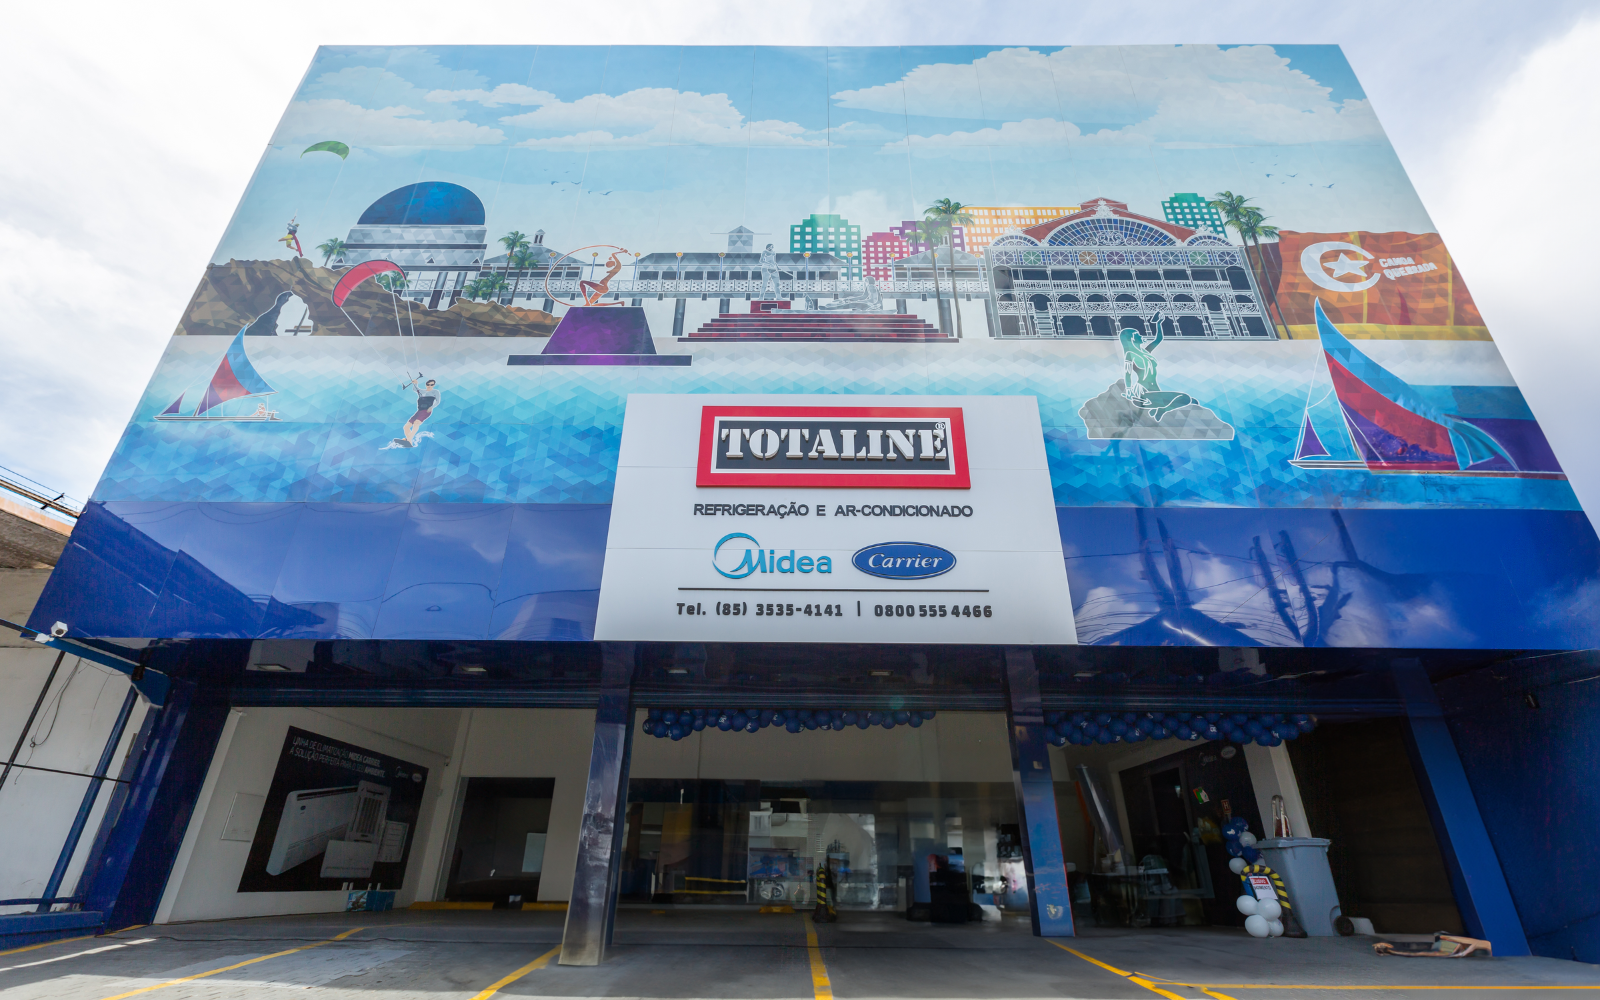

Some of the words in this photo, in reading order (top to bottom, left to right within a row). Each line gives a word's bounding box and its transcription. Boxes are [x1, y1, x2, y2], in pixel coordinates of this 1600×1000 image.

[1378, 256, 1416, 268] CANOA
[1382, 262, 1438, 281] QUEBRADA
[693, 501, 810, 520] REFRIGERAÇÃO
[816, 504, 826, 517] E
[834, 504, 974, 518] AR-CONDICIONADO
[868, 552, 943, 570] Carrier
[676, 602, 707, 616] Tel.
[715, 601, 748, 617] (85)
[755, 603, 843, 617] 3535-4141
[874, 604, 916, 618] 0800
[918, 604, 948, 618] 555
[950, 604, 993, 618] 4466
